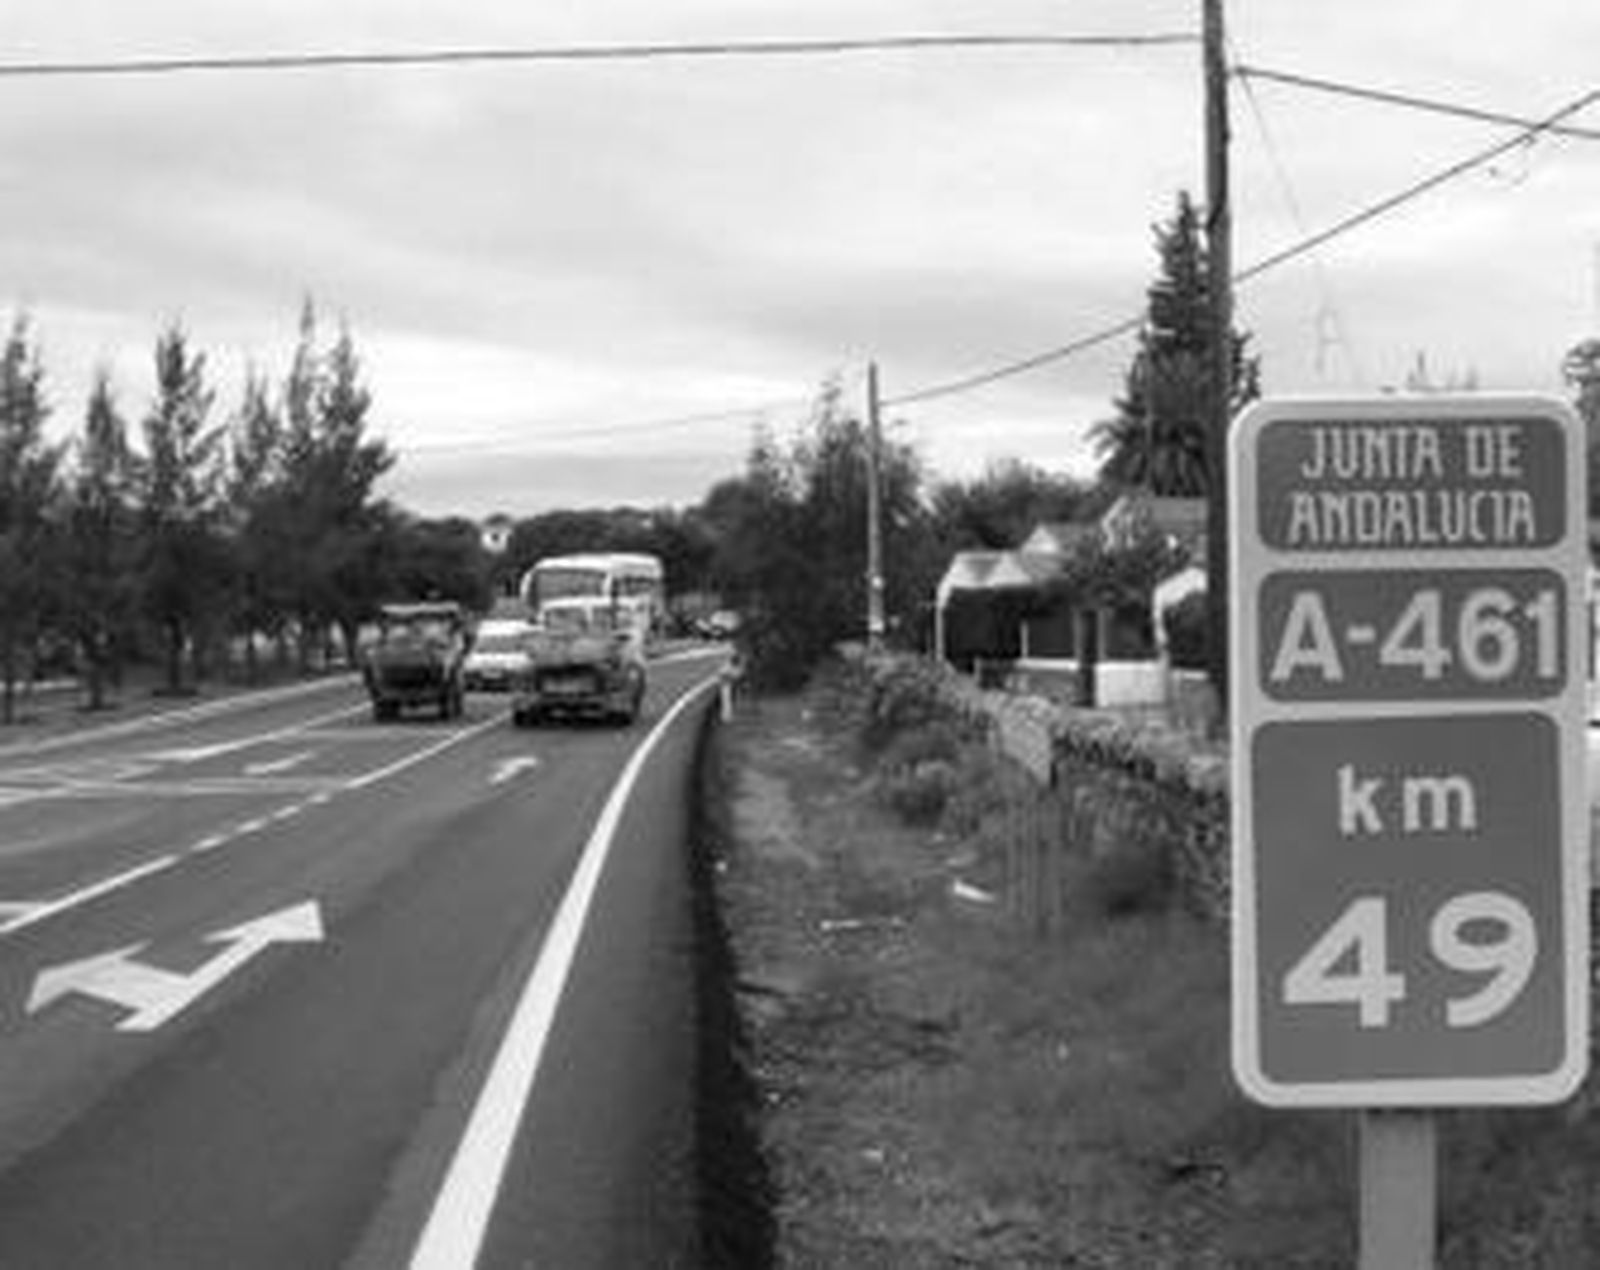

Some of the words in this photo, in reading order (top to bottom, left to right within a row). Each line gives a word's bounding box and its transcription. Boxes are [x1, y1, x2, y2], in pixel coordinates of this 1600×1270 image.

[1300, 425, 1443, 479] JUNTA
[1466, 425, 1523, 478] DE
[1288, 490, 1535, 544] ANDALUCIA
[1269, 589, 1558, 681] A-461
[1336, 763, 1477, 835] km
[1282, 890, 1538, 1028] 49
